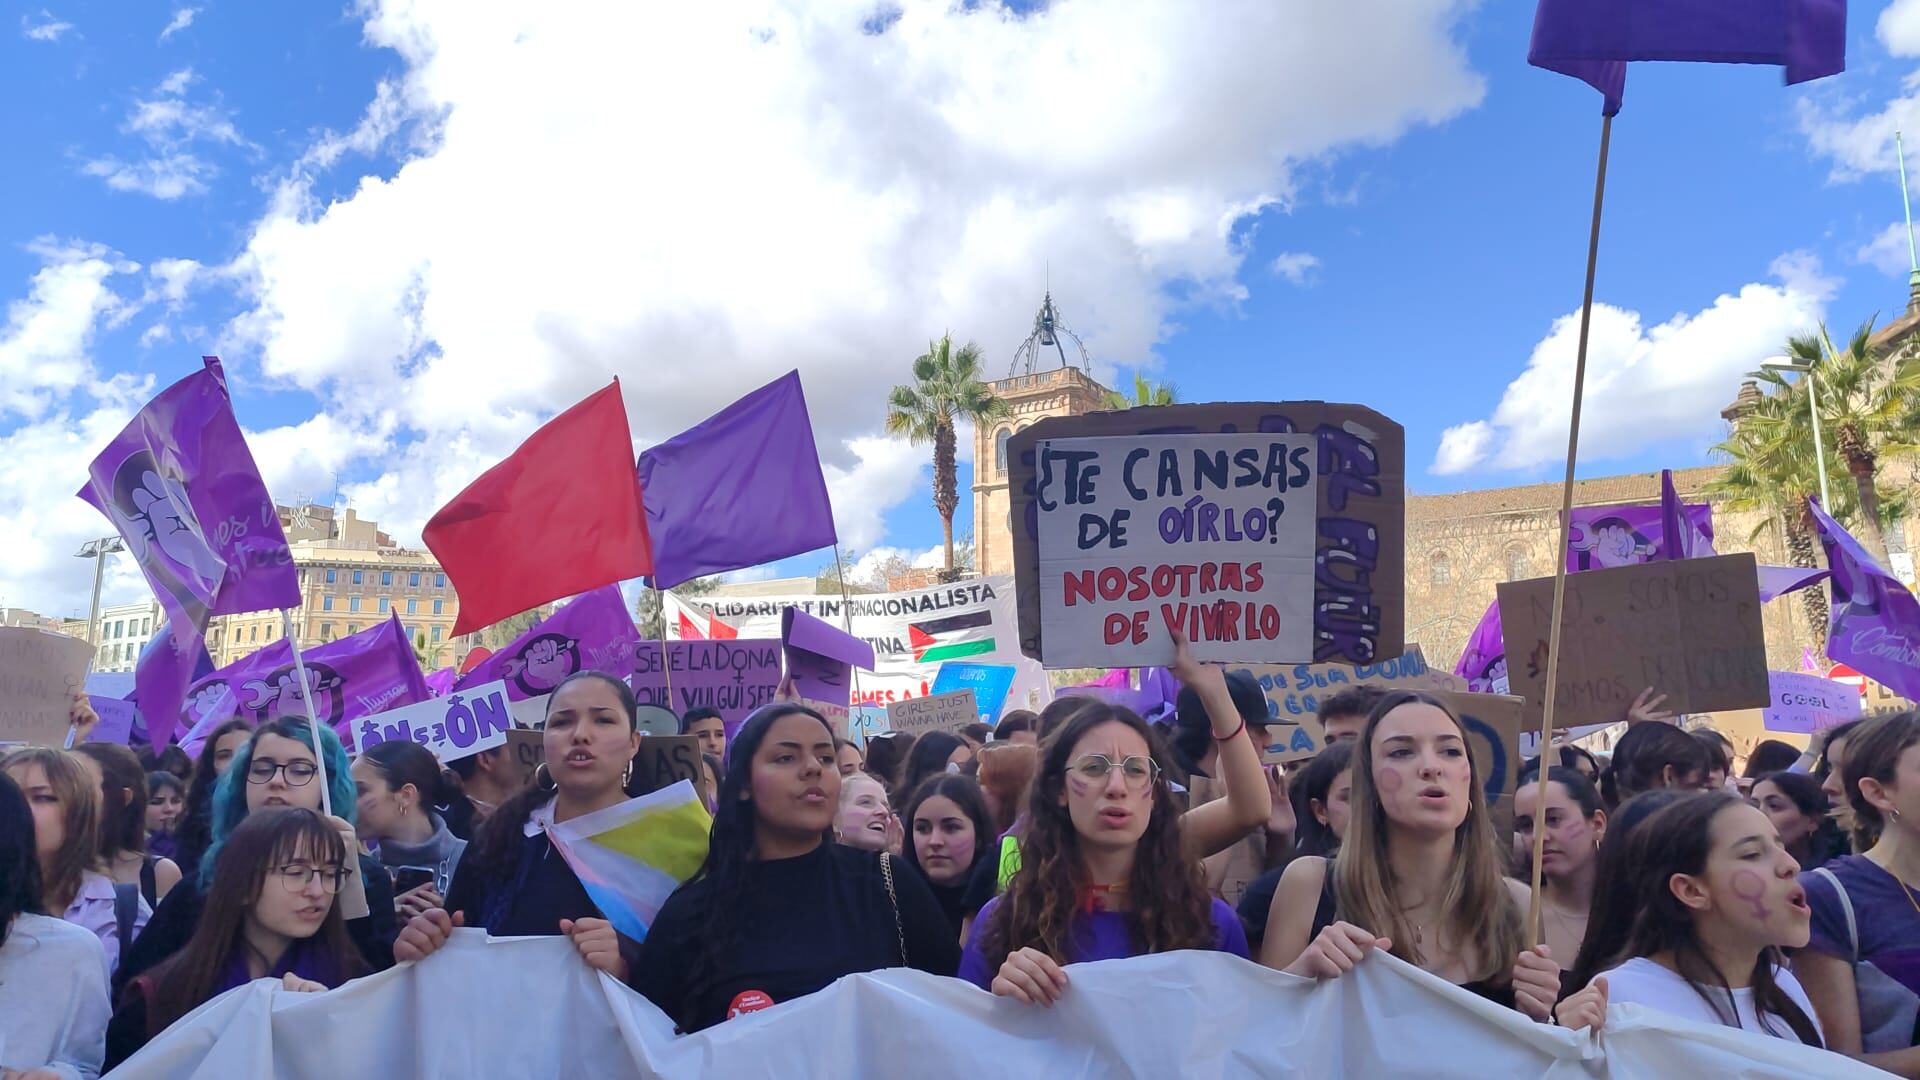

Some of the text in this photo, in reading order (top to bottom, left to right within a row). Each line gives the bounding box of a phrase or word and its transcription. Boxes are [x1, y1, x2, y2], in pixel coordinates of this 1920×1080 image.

[1037, 441, 1101, 511] ¿TE
[1123, 443, 1310, 500] CANSAS
[1077, 495, 1285, 549] DE OÍRLO?
[1064, 562, 1264, 606] NOSOTRAS
[1627, 567, 1730, 613] SOMOS
[1104, 610, 1150, 645] DE
[895, 701, 935, 717] GIRLS
[937, 693, 971, 710] JUST
[896, 713, 935, 728] WANNA
